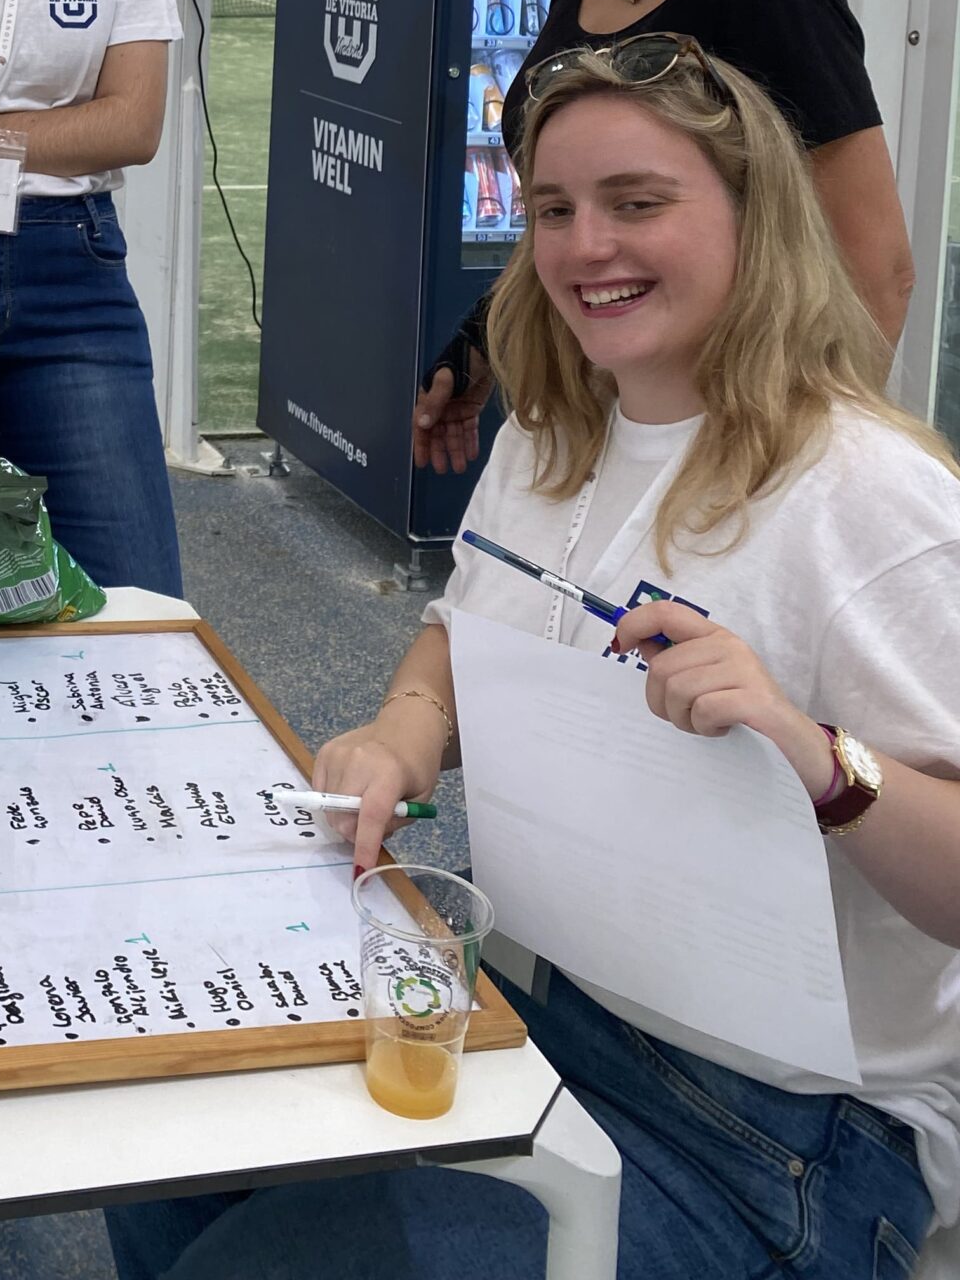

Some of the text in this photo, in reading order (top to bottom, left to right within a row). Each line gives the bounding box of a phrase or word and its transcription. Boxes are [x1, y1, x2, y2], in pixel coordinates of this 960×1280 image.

[335, 35, 364, 60] Madrid
[313, 117, 383, 172] VITAMIN
[312, 149, 352, 195] WELL
[287, 399, 367, 468] www.fitvending.es
[0, 681, 29, 713] Miguel
[64, 672, 88, 711] Sabrina
[204, 981, 232, 1013] Hugo
